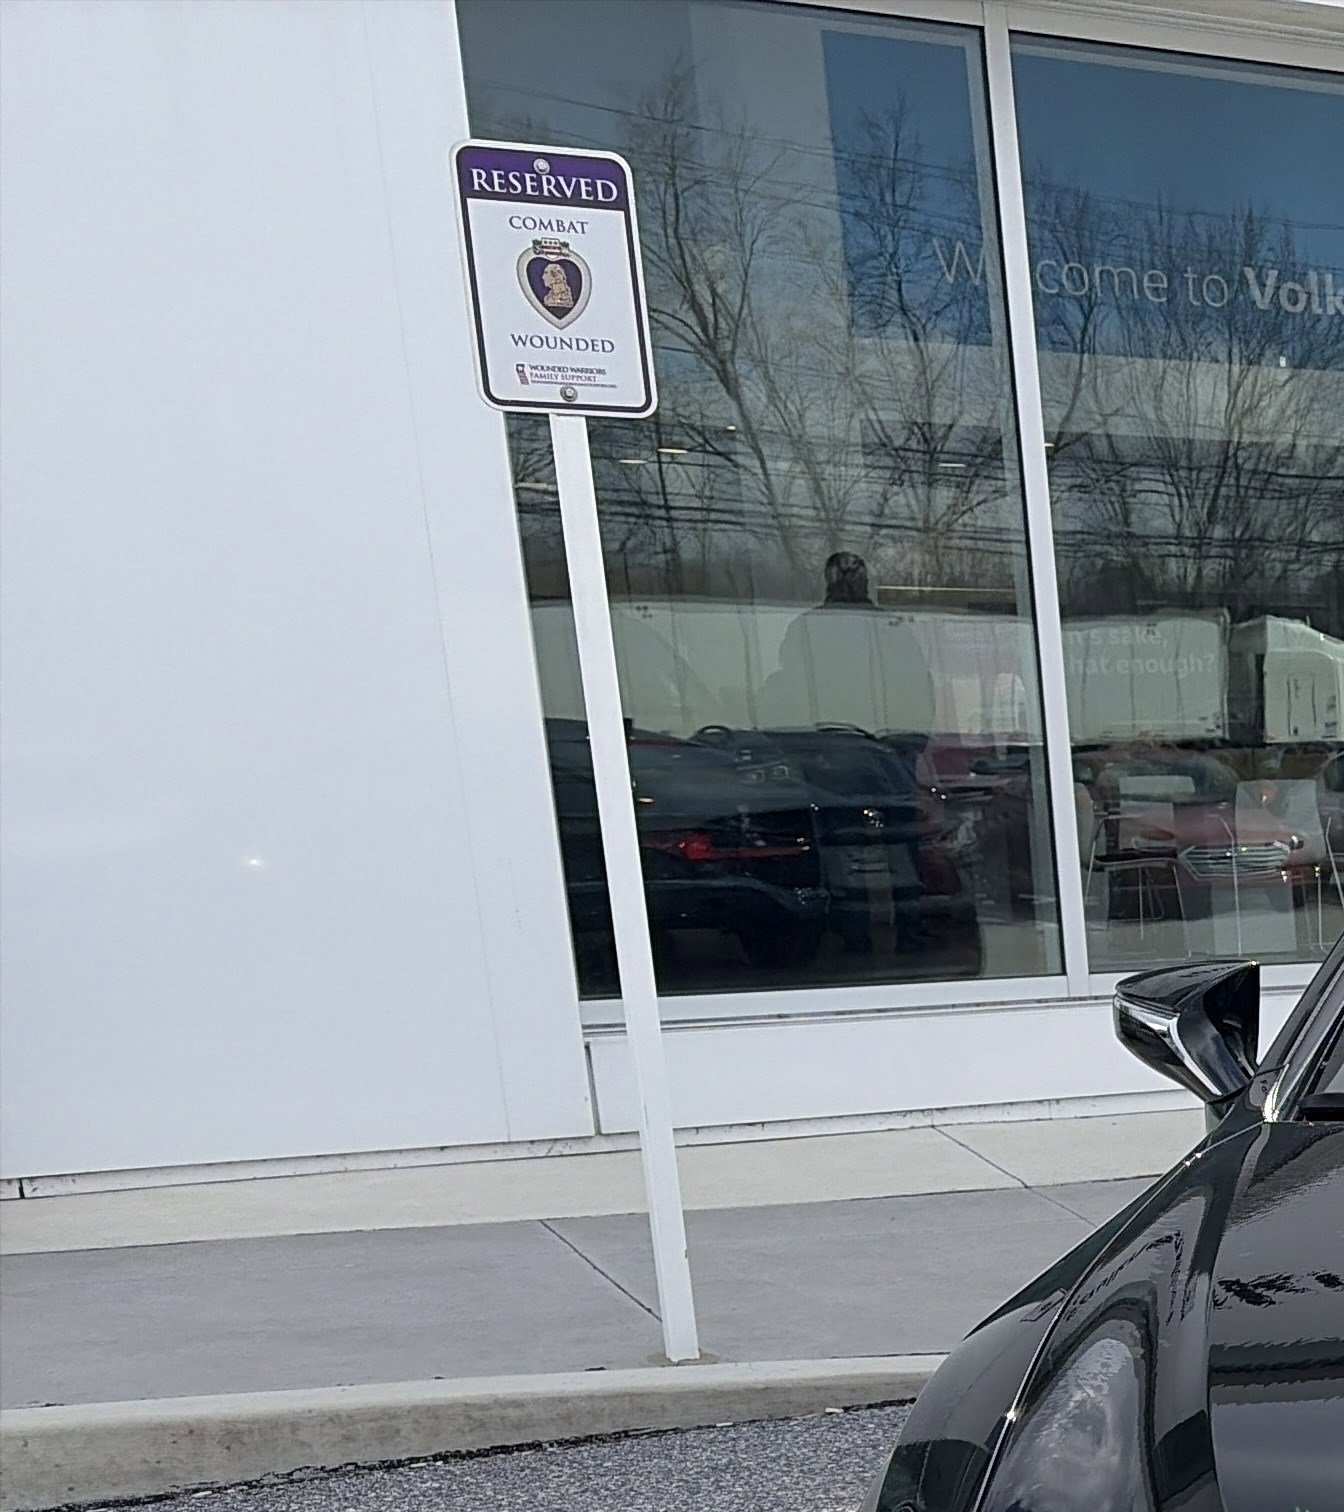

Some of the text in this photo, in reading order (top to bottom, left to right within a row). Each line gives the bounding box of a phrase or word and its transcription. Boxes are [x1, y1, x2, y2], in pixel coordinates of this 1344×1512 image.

[470, 168, 618, 202] RESERVED
[509, 215, 588, 234] COMBAT
[932, 237, 1168, 302] Wcome
[1183, 266, 1228, 307] to
[511, 334, 615, 353] WOUNDED
